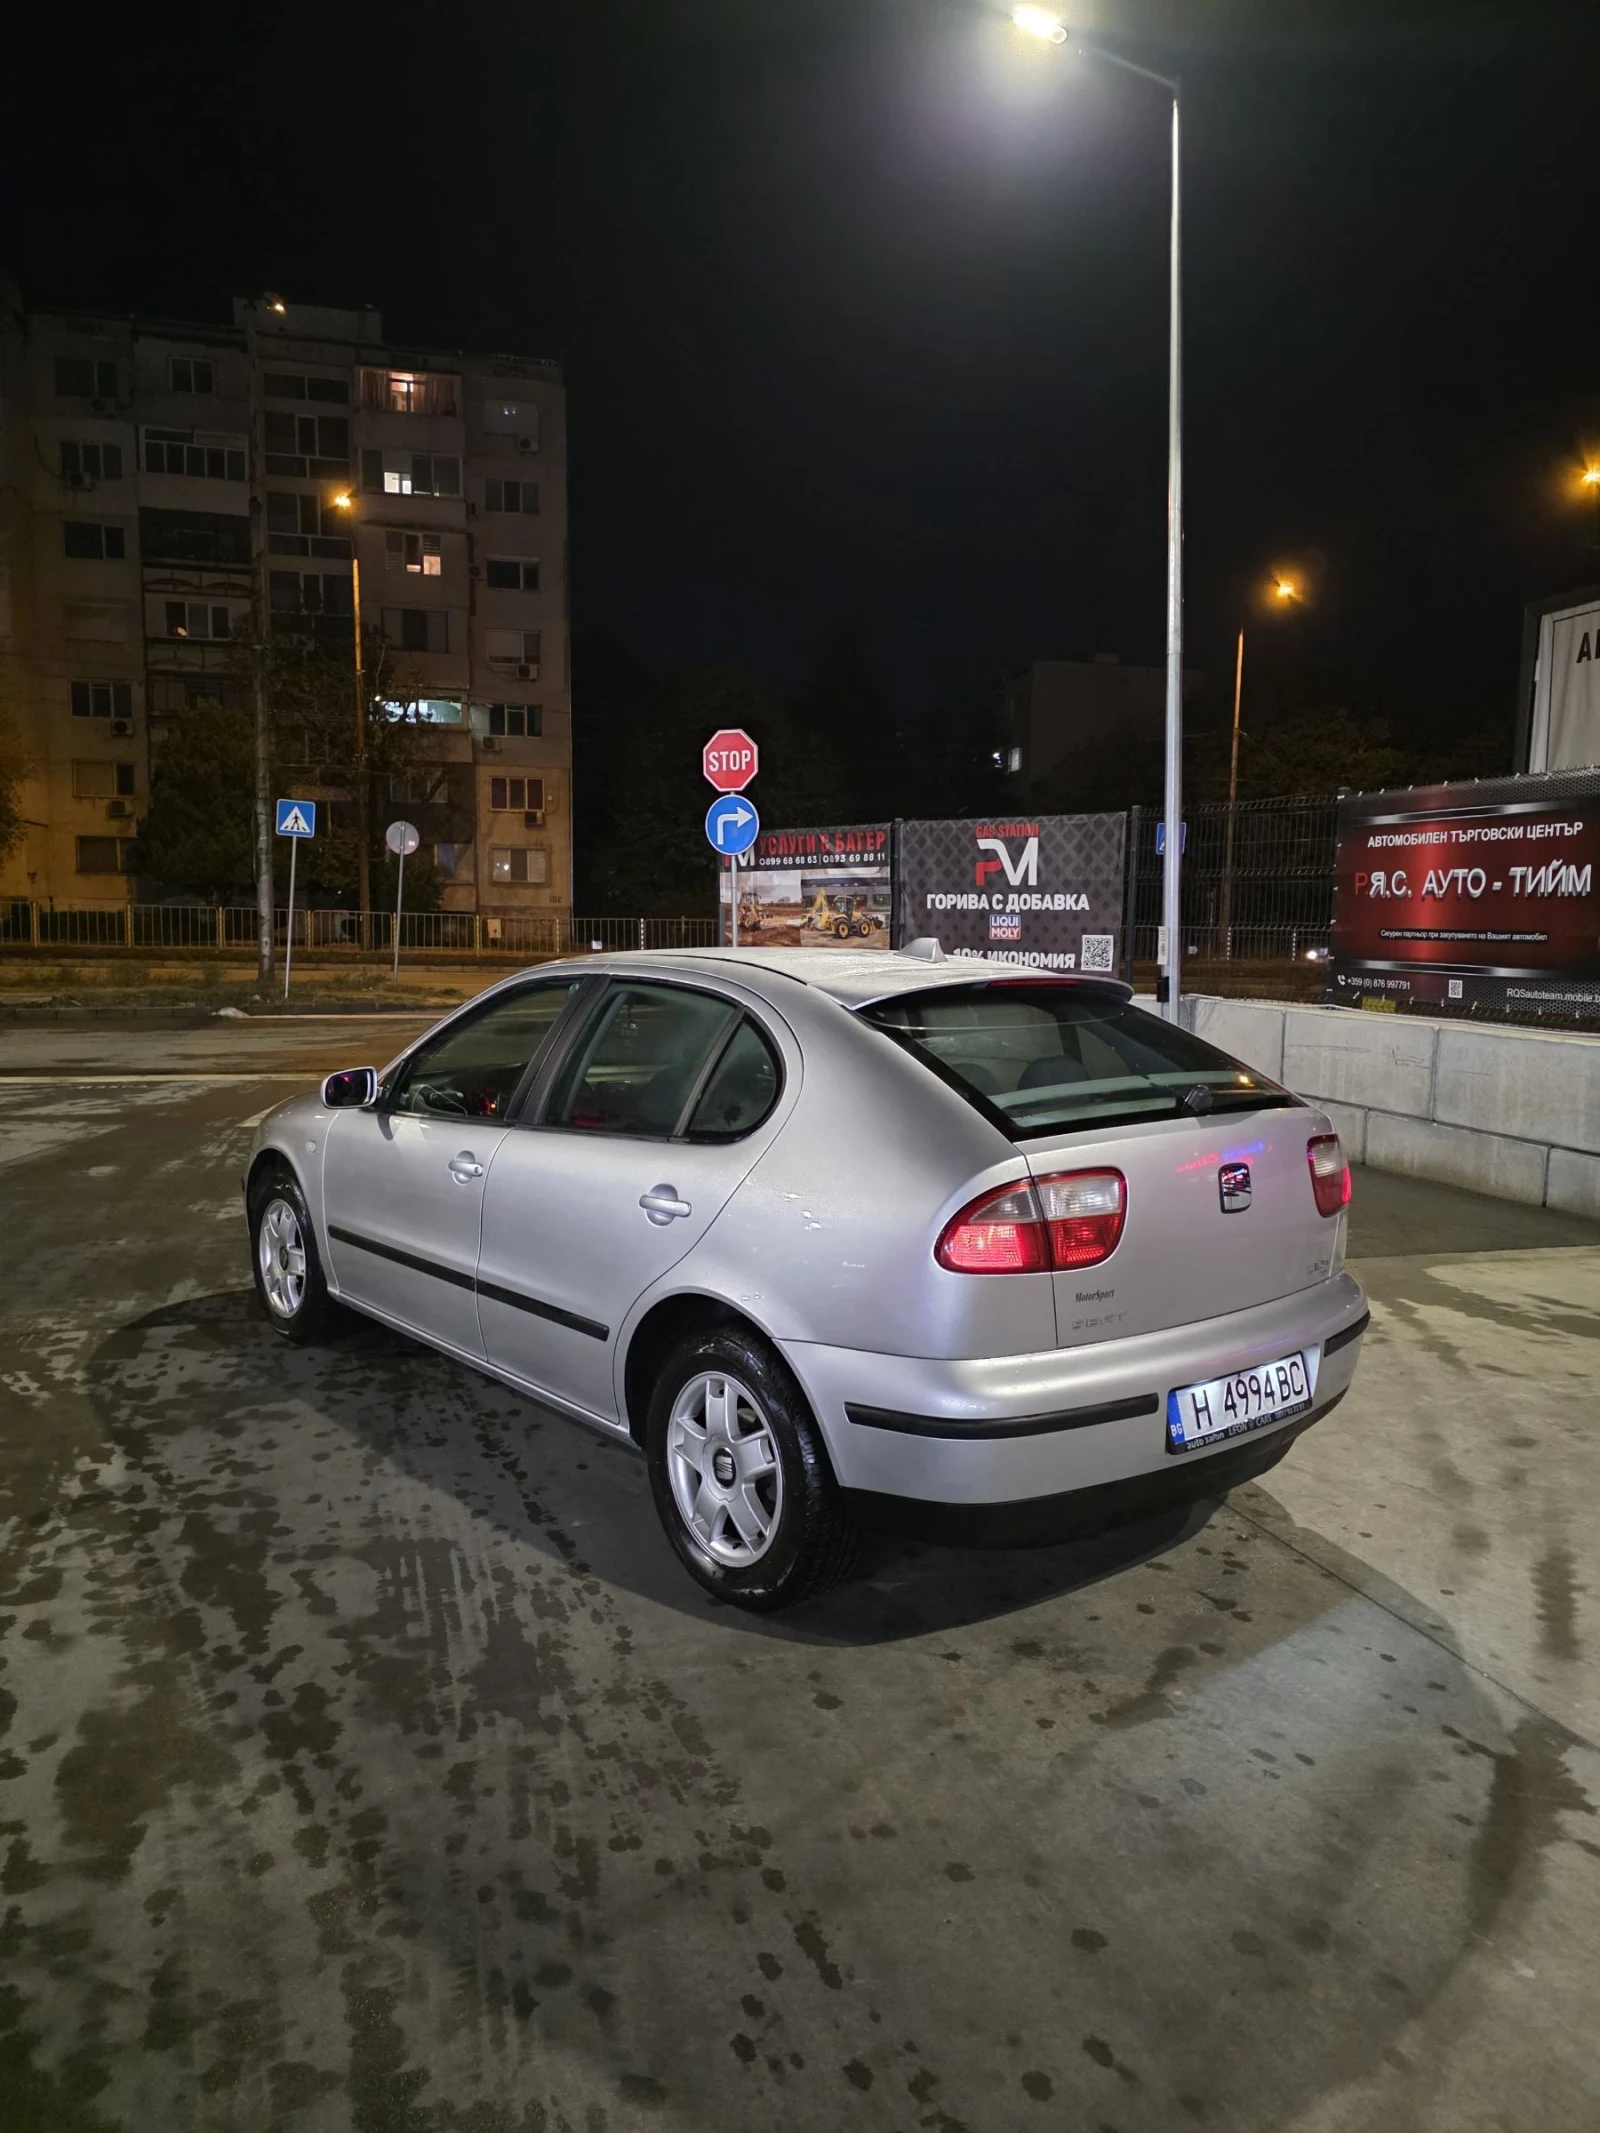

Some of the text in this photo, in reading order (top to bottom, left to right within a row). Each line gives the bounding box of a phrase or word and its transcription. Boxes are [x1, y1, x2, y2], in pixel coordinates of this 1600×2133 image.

[709, 750, 752, 772] STOP
[976, 823, 1040, 837] GAS STATION
[1367, 822, 1584, 848] АВТОМОБИЛЕН ТЪРГОВСКИ ЦЕНТЪР
[758, 834, 815, 855] УСЛУГИ
[835, 830, 886, 853] БАГЕР
[759, 852, 885, 866] 0899 68 68 63 0893 69 88 11
[1421, 868, 1487, 898] АУТО
[1509, 859, 1592, 897] ТИЙМ
[927, 894, 1090, 913] ГОРИВА С ДОБАВКА
[991, 916, 1019, 927] LIQUI
[991, 928, 1020, 938] MOLY
[987, 951, 1075, 968] ИКОНОМИЯ
[1347, 978, 1362, 986] +359
[1373, 979, 1385, 988] 876
[1075, 1289, 1114, 1302] MotorSport
[1191, 1389, 1213, 1430] H
[1170, 1423, 1183, 1437] BG
[1186, 1438, 1204, 1450] auto
[1205, 1432, 1225, 1444] salon
